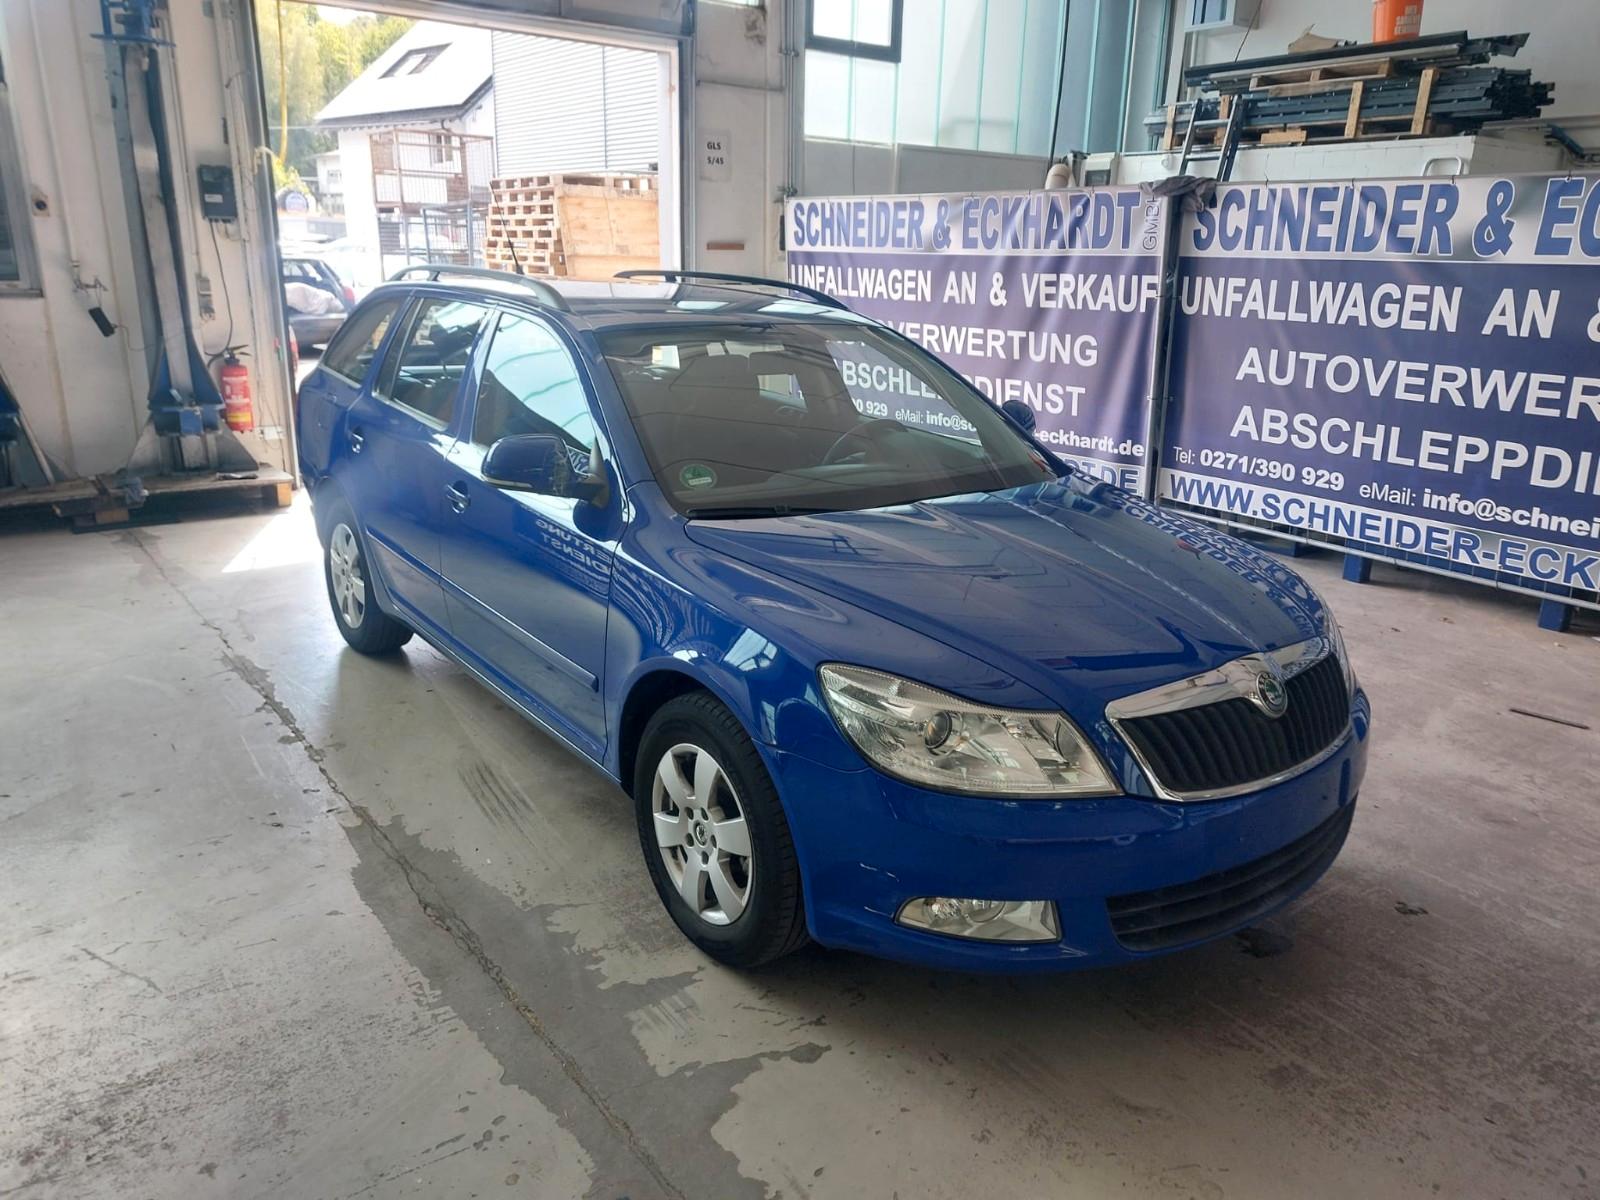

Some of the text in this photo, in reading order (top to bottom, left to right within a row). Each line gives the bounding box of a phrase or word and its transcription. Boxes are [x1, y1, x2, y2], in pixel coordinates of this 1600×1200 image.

[706, 142, 721, 150] GLS
[793, 190, 1141, 249] SCHNEIDER & ECKHARDT
[1192, 182, 1460, 257] SCHNEIDER
[1472, 178, 1516, 257] &
[790, 264, 1159, 314] UNFALLWAGEN AN & VERKAUF
[1180, 276, 1463, 334] UNFALLWAGEN
[1481, 287, 1561, 340] AN
[866, 402, 888, 417] 929
[895, 408, 924, 424] eMail:
[1235, 346, 1600, 423] AUTOVERWER
[1230, 404, 1600, 496] ABSCHLEPPDI
[1173, 445, 1600, 540] Tel: 0271/390 929 eMail: info@schnei
[1169, 472, 1600, 590] WWW.SCHNEIDER-ECK
